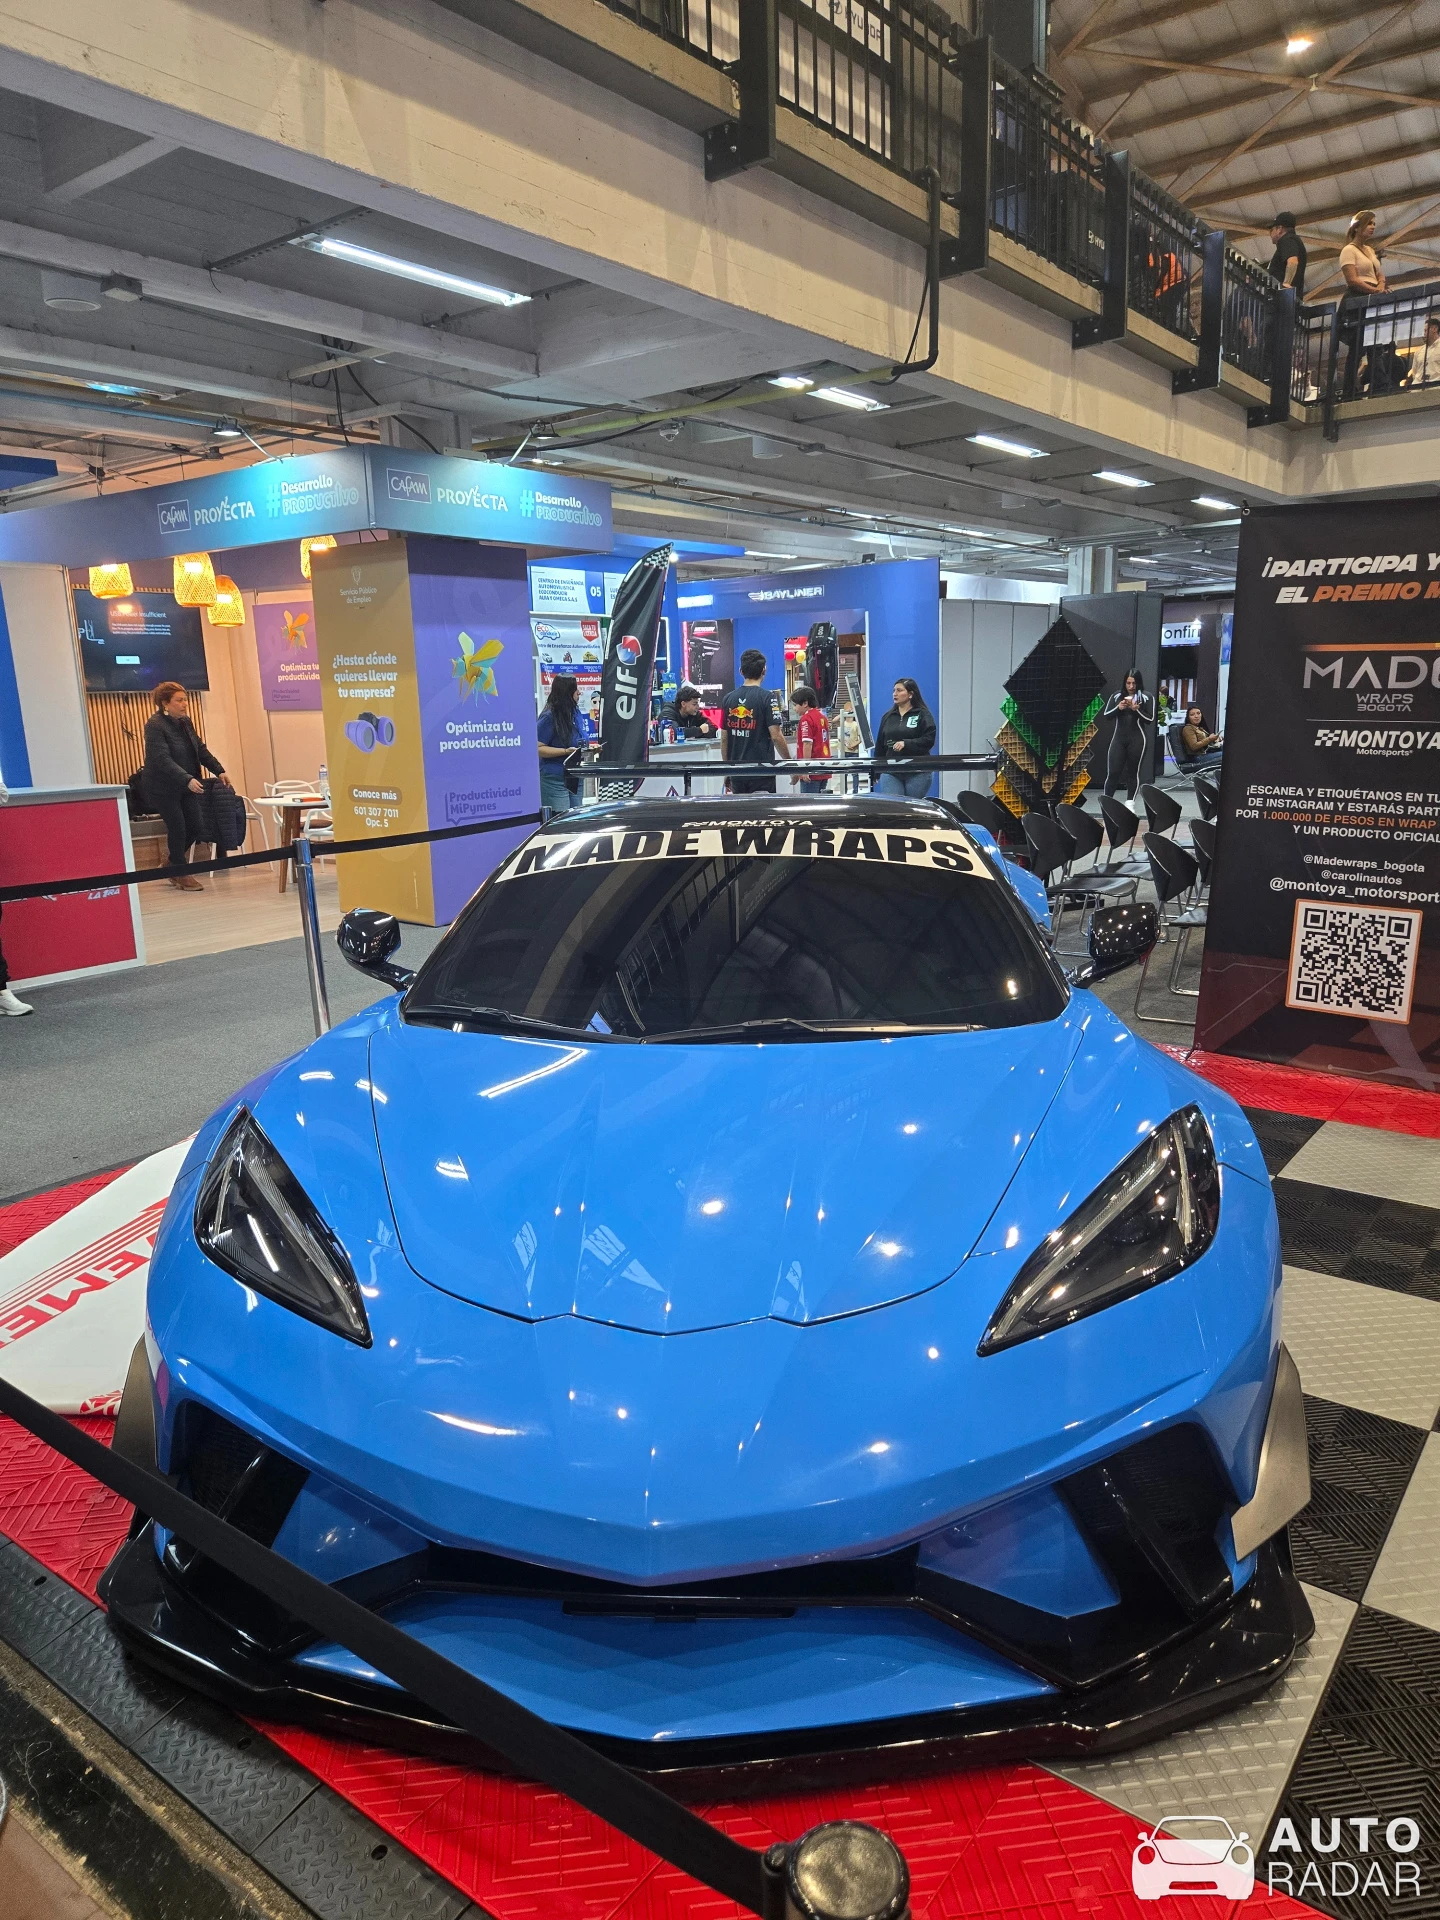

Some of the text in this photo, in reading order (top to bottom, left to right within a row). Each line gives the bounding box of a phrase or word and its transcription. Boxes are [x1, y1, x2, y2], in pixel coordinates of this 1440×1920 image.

[282, 485, 359, 515] PRODUCTIVO
[436, 485, 508, 512] PROYECTA
[194, 496, 255, 525] PROYECTA
[536, 505, 602, 526] PRODUCTIVO
[1261, 554, 1418, 577] ¡PARTICIPA
[590, 585, 601, 597] 05
[764, 586, 822, 600] BAYLINER
[1275, 586, 1309, 604] EL
[1312, 581, 1422, 602] PREMIO
[139, 610, 167, 618] Insufficient
[280, 662, 320, 673] Optimiza tu
[333, 651, 397, 668] ¿Hasta dónde
[334, 669, 398, 684] quieres llevar
[338, 685, 396, 700] tu empresa?
[1356, 693, 1414, 704] WRAPS
[1357, 704, 1412, 712] BOGOTA
[445, 720, 514, 736] Optimiza tu
[740, 719, 756, 730] Bull
[440, 735, 521, 753] productividad
[1339, 730, 1440, 750] MONTOYA
[353, 788, 398, 800] Conoce más
[449, 787, 522, 802] Productividad
[1246, 785, 1304, 797] ¡ESCANEA
[1307, 787, 1315, 797] Y
[1317, 788, 1402, 802] ETIQUÉTANOS
[1405, 792, 1423, 802] EN
[353, 805, 399, 818] 601 307 7011
[450, 802, 497, 815] MiPymes
[1248, 797, 1263, 807] DE
[1266, 798, 1334, 811] INSTAGRAM
[1337, 802, 1345, 811] Y
[1347, 803, 1404, 815] ESTARÁS
[365, 817, 389, 828] Opc. 5
[708, 819, 813, 827] MONTOYA
[1235, 809, 1437, 829] POR 1.000.000 DE PESOS EN WRAP
[1293, 824, 1440, 844] Y UN PRODUCTO OFICIAL
[513, 828, 974, 876] MADE WRAPS
[1303, 854, 1425, 873] @Madewraps_bogota
[1321, 869, 1403, 886] @carolinautos
[87, 892, 101, 900] LA
[1269, 877, 1440, 903] @montoya_motorsport
